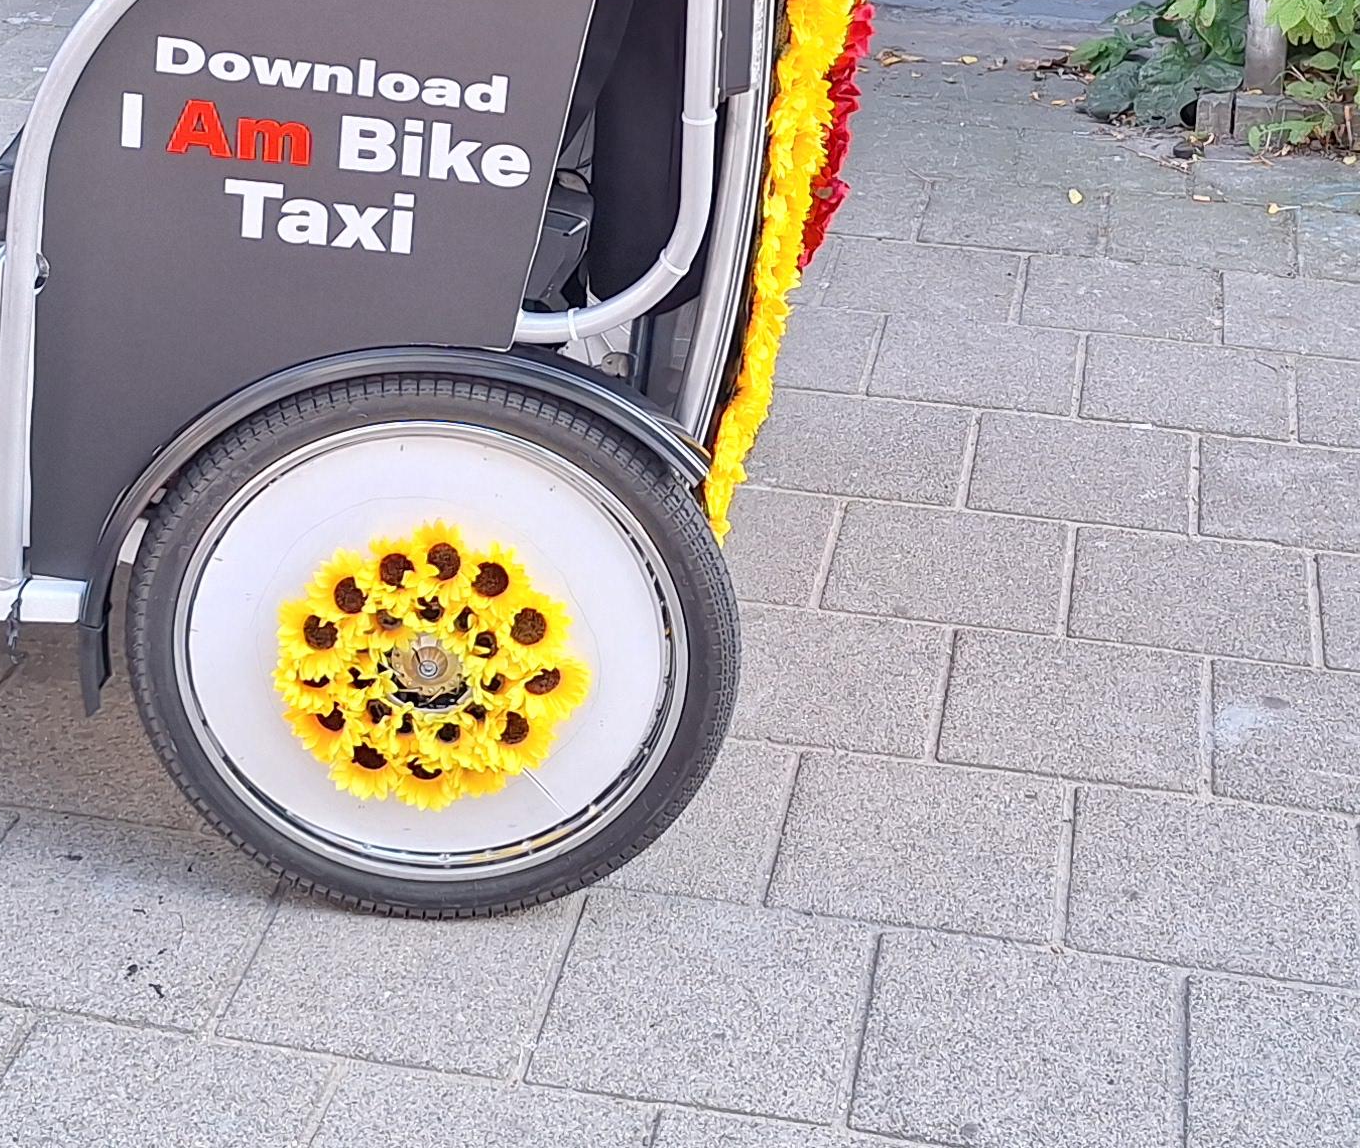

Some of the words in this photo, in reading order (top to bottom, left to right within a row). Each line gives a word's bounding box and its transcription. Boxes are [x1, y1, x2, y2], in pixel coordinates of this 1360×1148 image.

[155, 34, 510, 114] Download
[119, 91, 144, 150] I
[166, 98, 313, 167] Am
[338, 113, 532, 189] Bike
[223, 177, 416, 256] Taxi
